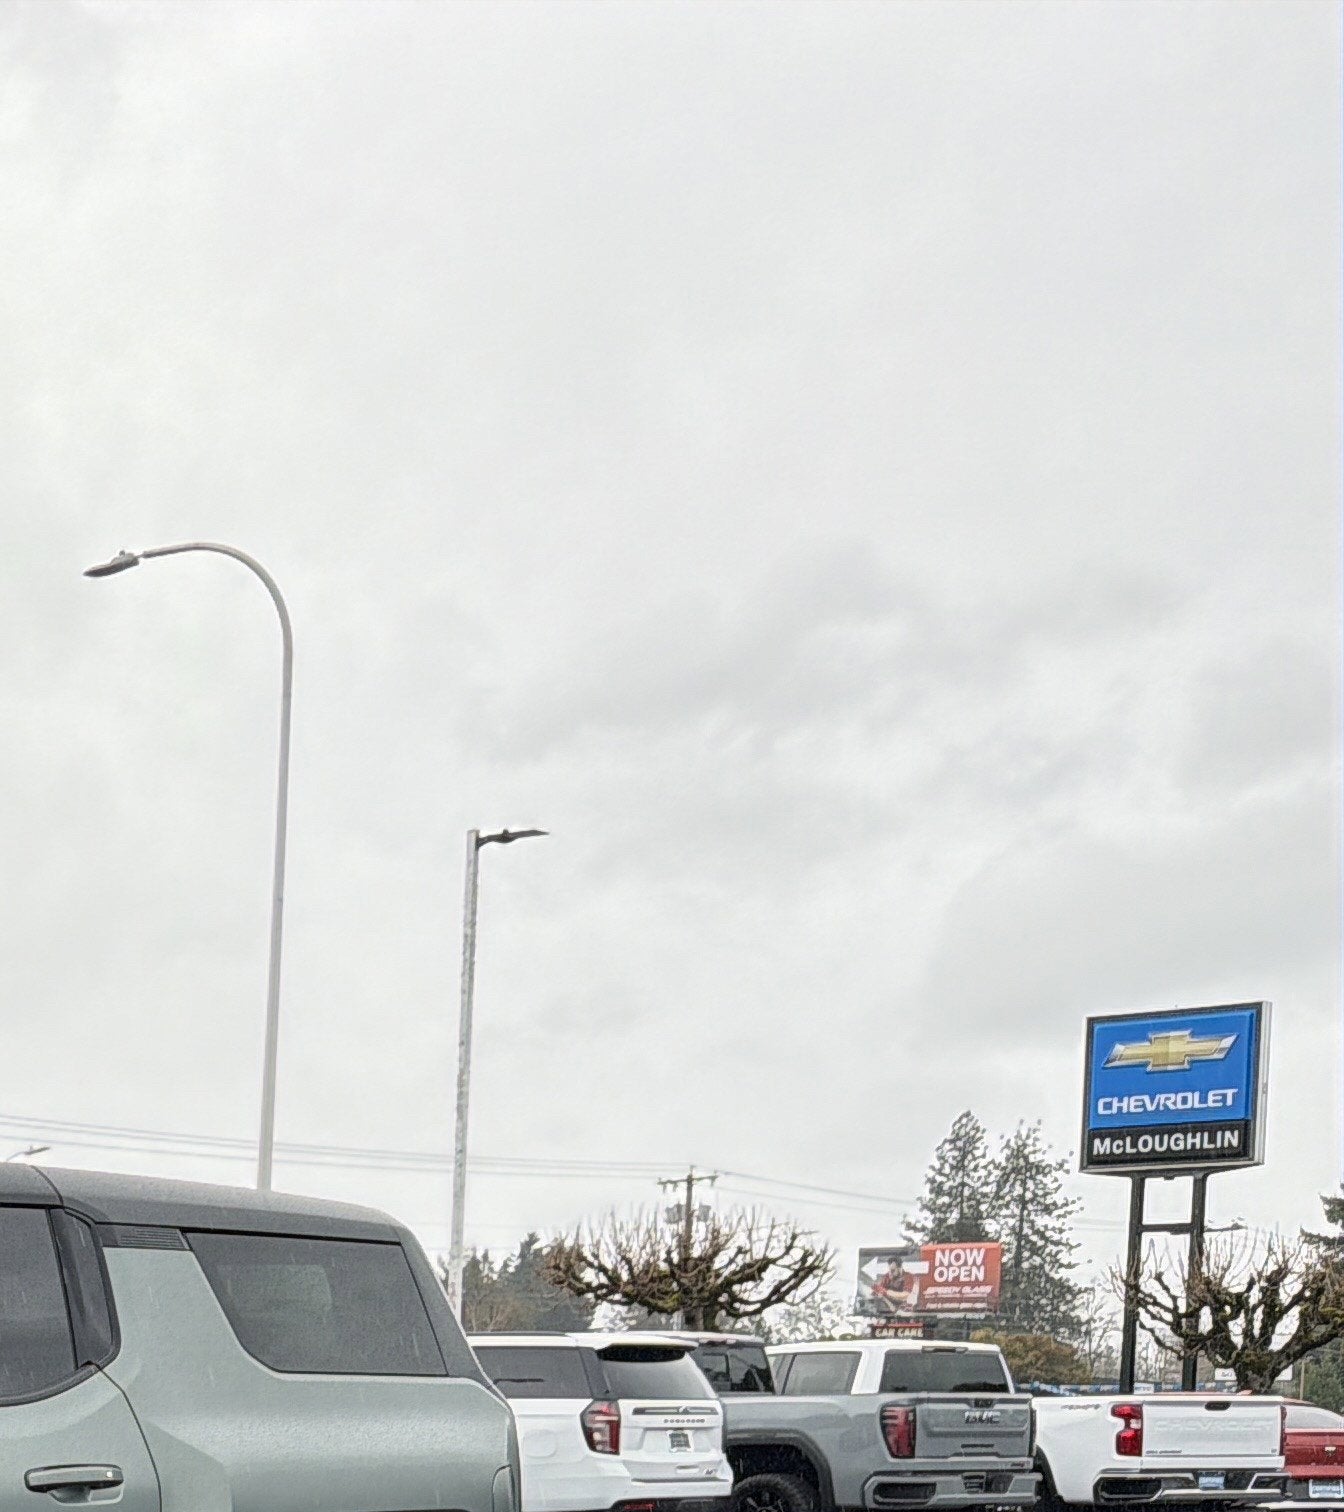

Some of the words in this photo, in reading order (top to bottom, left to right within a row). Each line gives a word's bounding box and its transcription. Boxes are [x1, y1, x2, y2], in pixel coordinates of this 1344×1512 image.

[1097, 1088, 1239, 1115] CHEVROLET
[1092, 1129, 1240, 1156] McLOUGHLIN
[934, 1248, 986, 1267] NOW
[933, 1265, 985, 1283] OPEN
